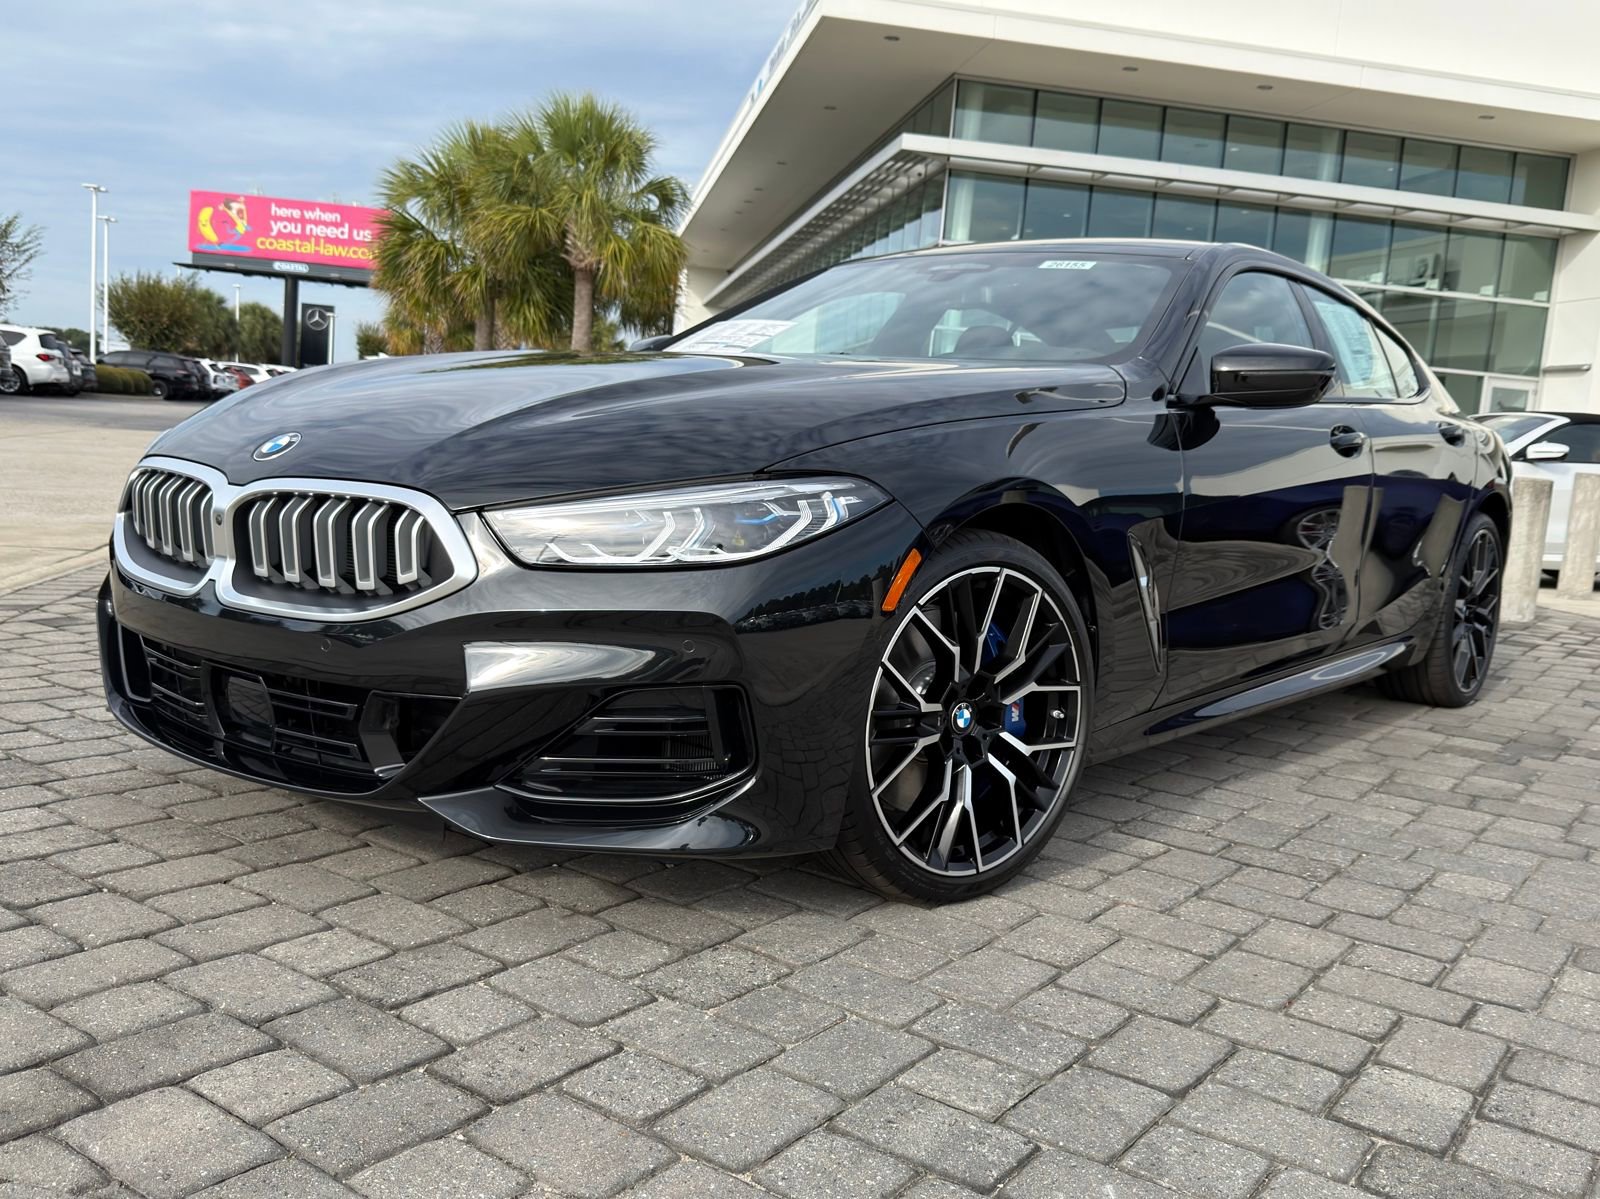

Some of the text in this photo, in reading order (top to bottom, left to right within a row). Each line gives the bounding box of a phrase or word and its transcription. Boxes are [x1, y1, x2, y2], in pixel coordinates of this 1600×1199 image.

[271, 202, 341, 223] here when
[269, 219, 372, 242] you need us
[256, 236, 379, 260] coastal-law.co
